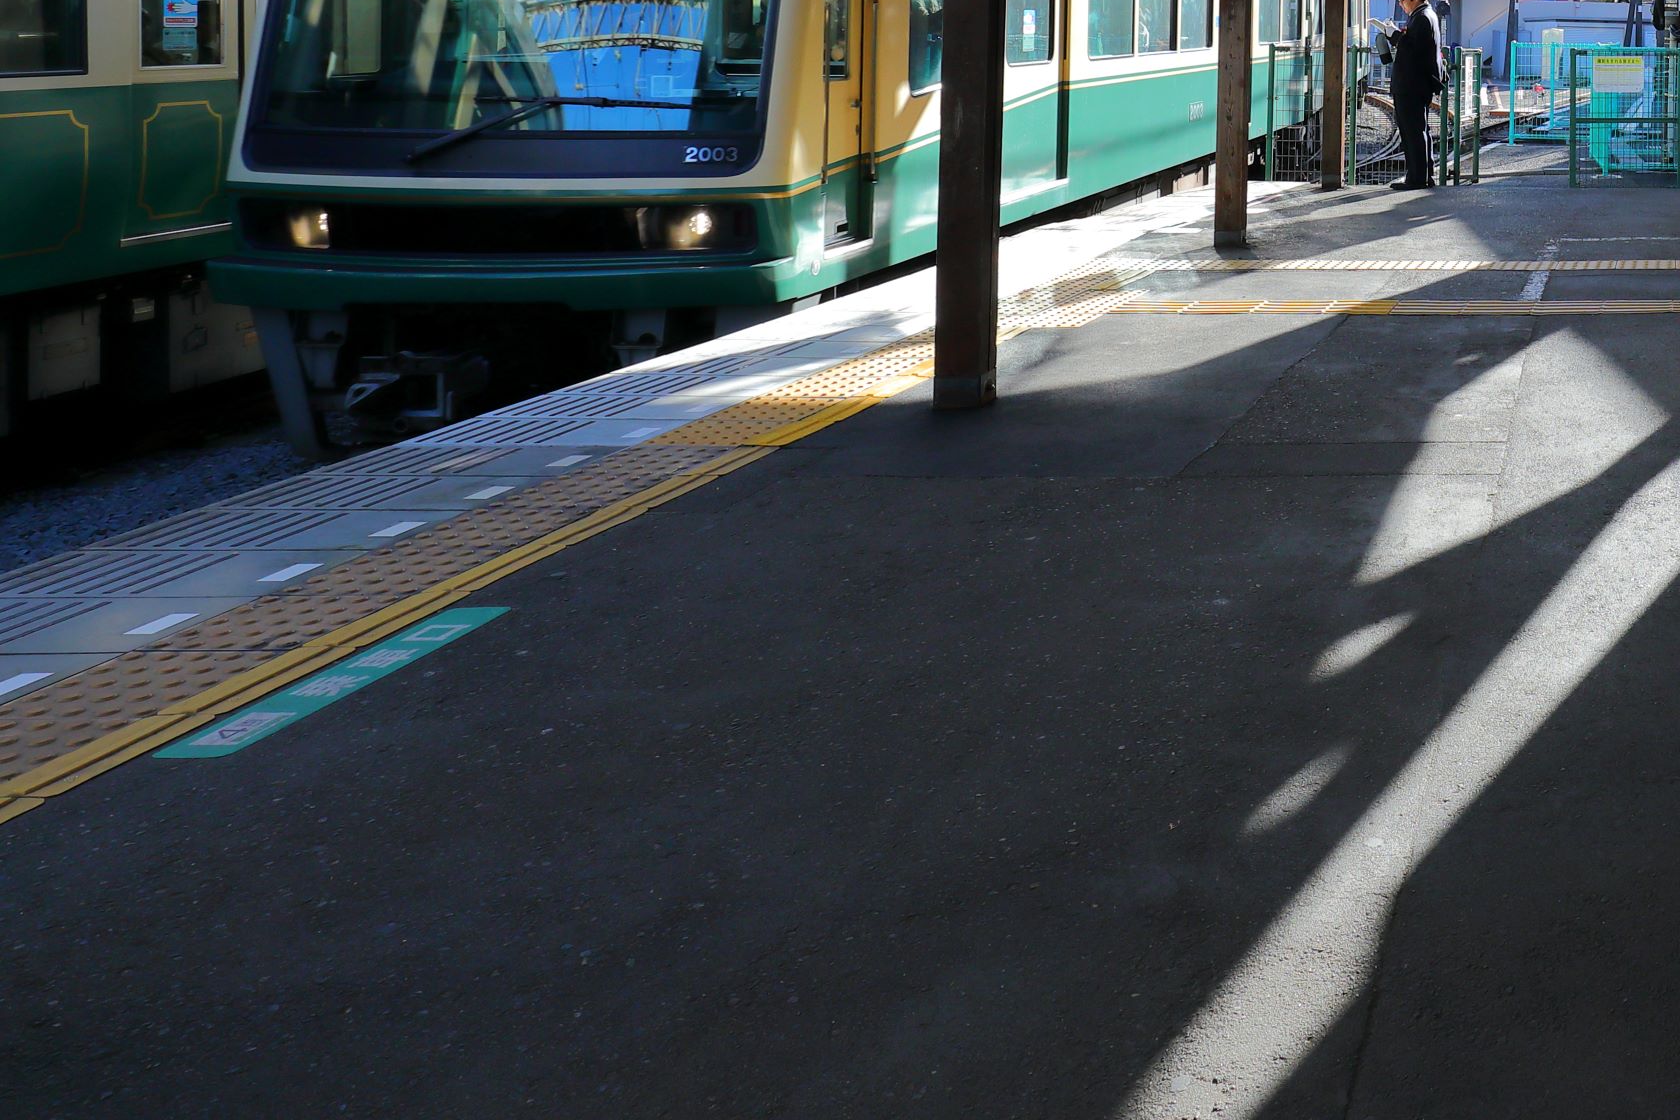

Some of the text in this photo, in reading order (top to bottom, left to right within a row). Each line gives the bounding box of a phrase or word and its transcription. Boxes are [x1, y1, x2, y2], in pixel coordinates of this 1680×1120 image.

[685, 146, 738, 162] 2003
[289, 624, 472, 697] 乗車口
